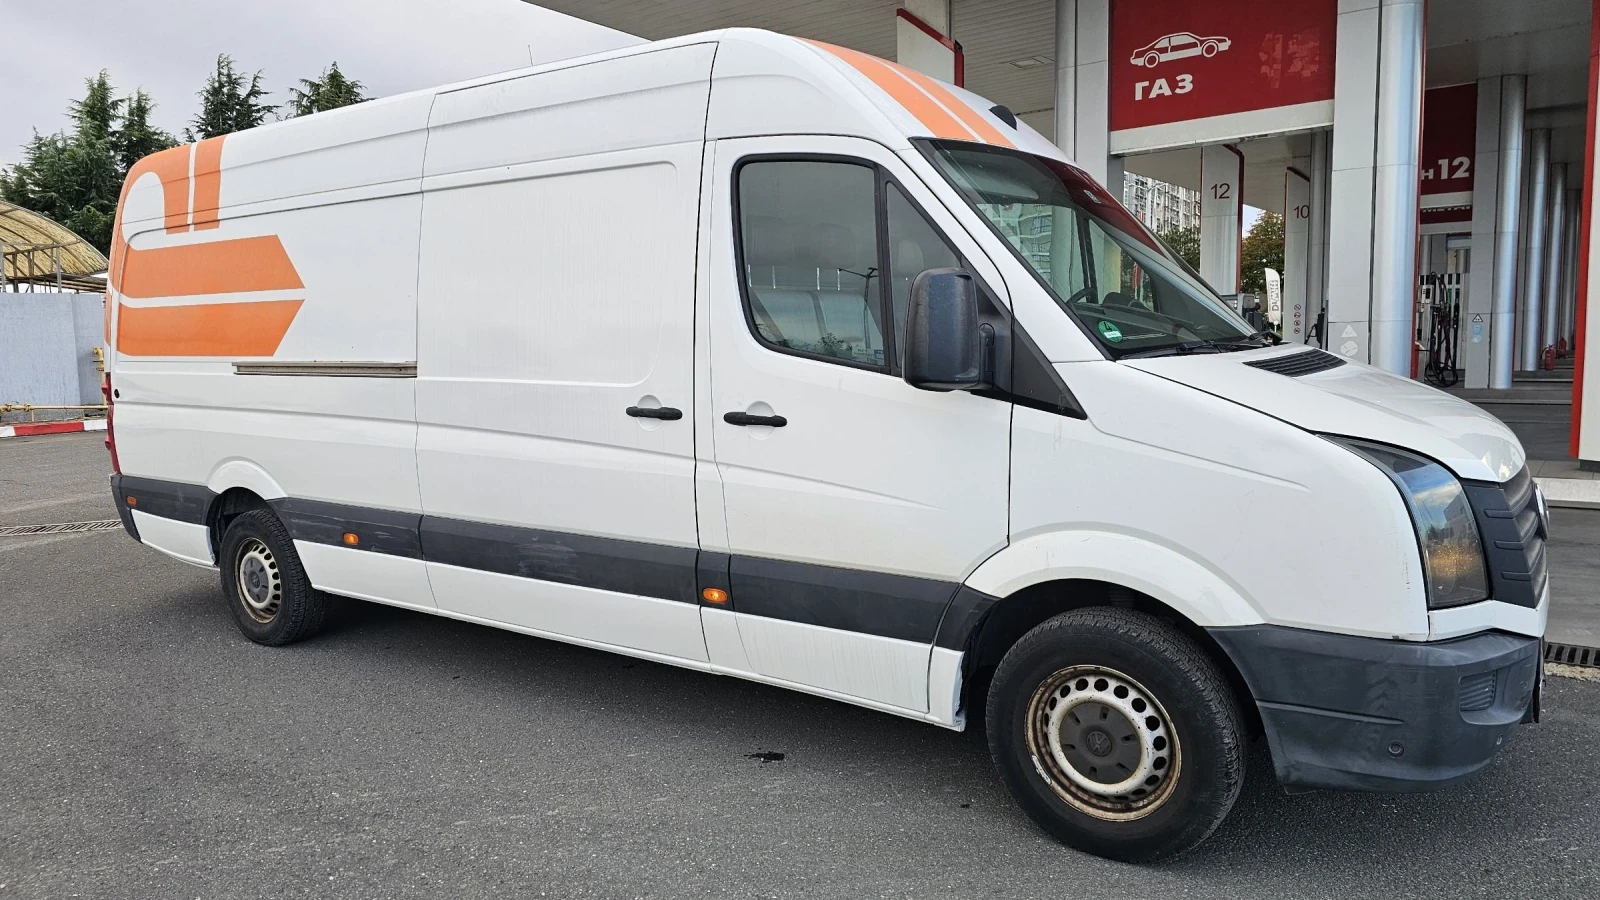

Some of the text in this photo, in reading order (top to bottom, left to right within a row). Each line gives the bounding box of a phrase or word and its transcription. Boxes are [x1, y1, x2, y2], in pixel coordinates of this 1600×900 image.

[1134, 73, 1194, 101] ГАЗ
[1437, 156, 1471, 180] 12
[1210, 183, 1230, 200] 12
[1293, 204, 1310, 219] 10
